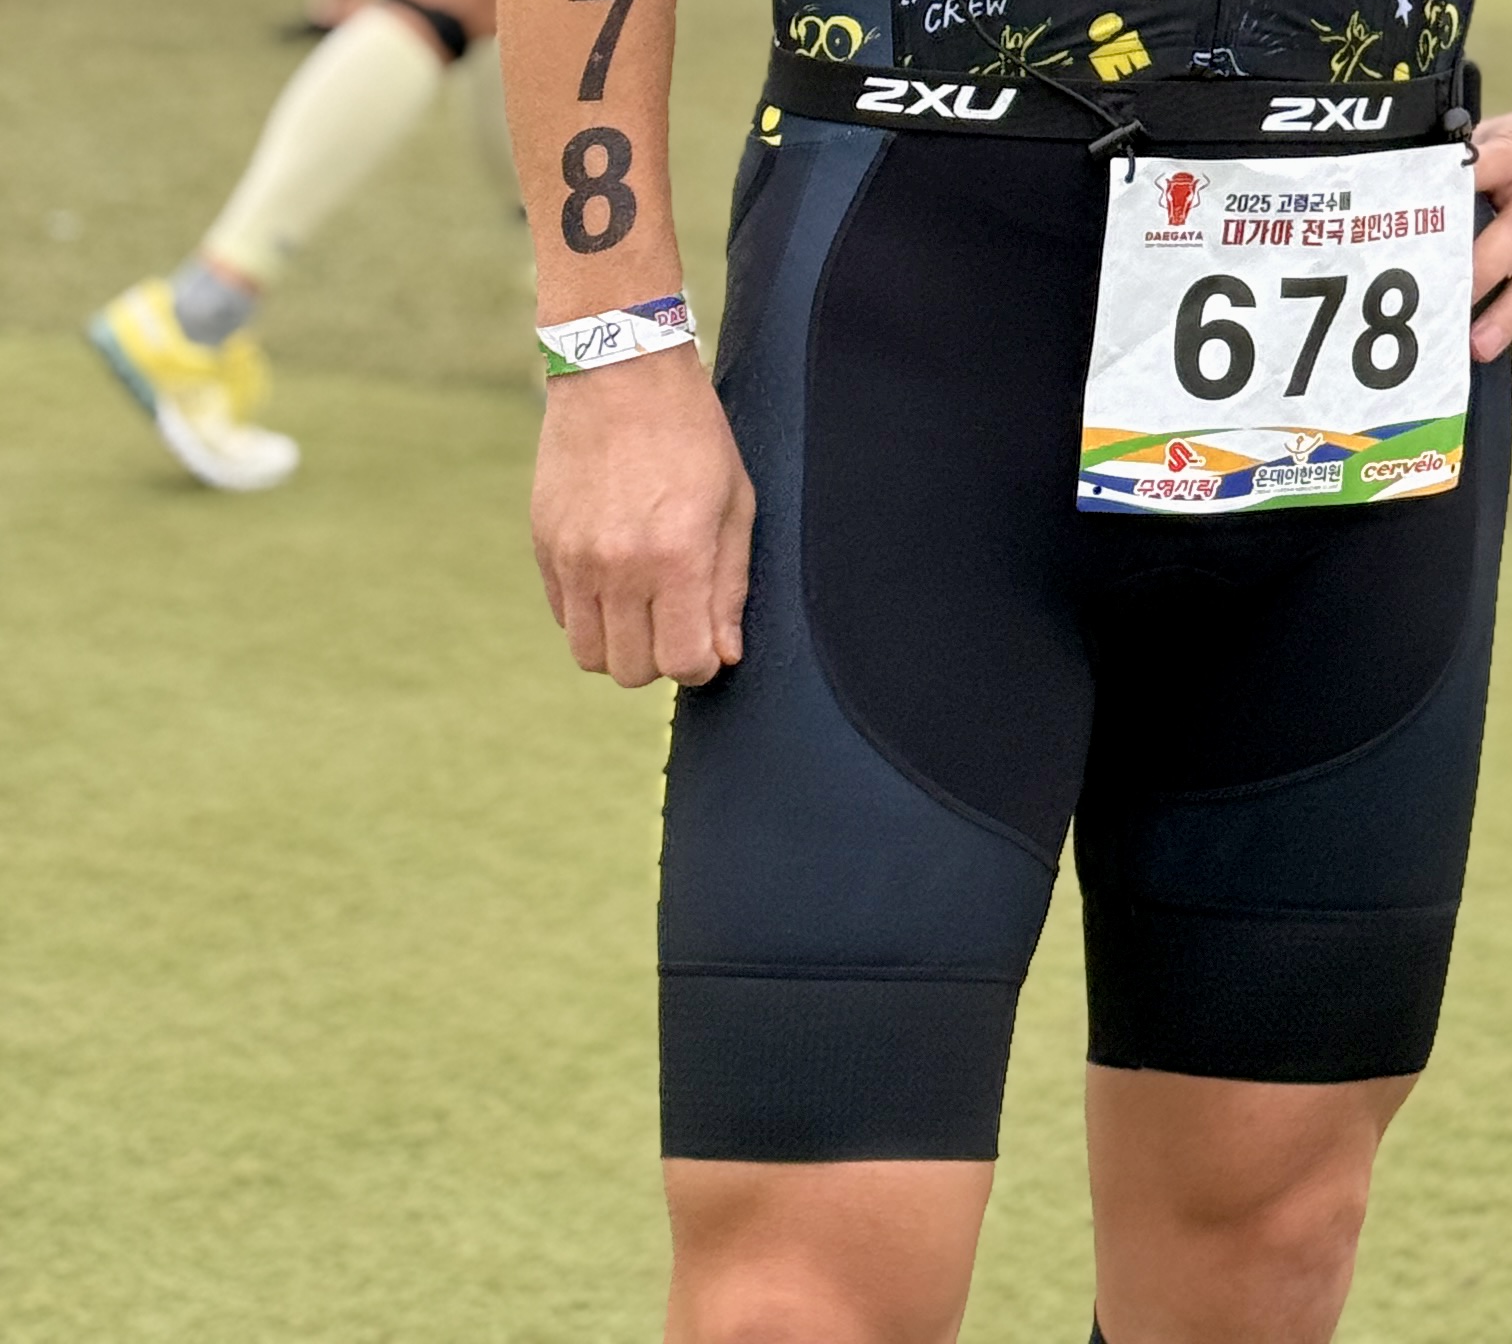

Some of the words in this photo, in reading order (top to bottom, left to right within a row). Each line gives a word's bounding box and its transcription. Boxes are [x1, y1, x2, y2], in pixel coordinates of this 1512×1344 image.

[855, 76, 1017, 122] 2XU
[1260, 95, 1394, 133] 2XU
[1224, 192, 1273, 214] 2025
[1144, 230, 1204, 242] DAEGAYA
[1221, 217, 1294, 247] 대가야
[1301, 216, 1345, 247] 전국
[1350, 209, 1410, 245] 철인3종
[1413, 204, 1446, 237] 대회
[1173, 267, 1421, 401] 678
[1362, 452, 1445, 480] cervélo
